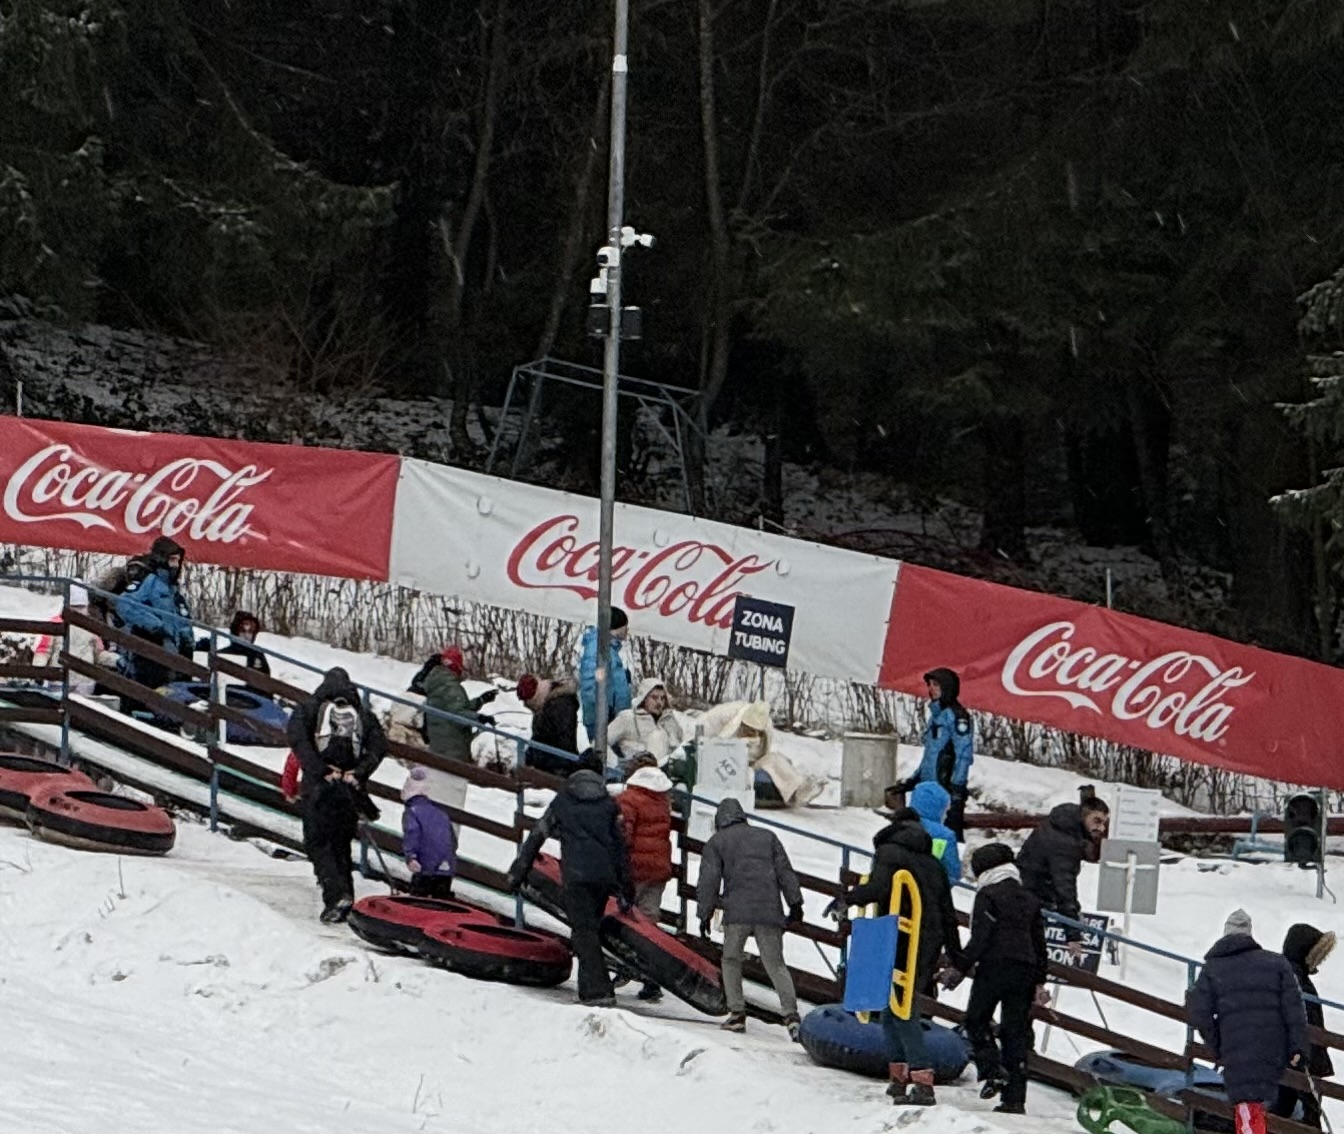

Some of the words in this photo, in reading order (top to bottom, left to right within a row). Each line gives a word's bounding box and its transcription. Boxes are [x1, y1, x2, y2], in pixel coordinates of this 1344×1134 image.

[4, 443, 274, 543] Coca-Cola
[735, 631, 786, 655] TUBING
[741, 610, 783, 633] ZONA
[1002, 621, 1256, 742] Coca-Cola
